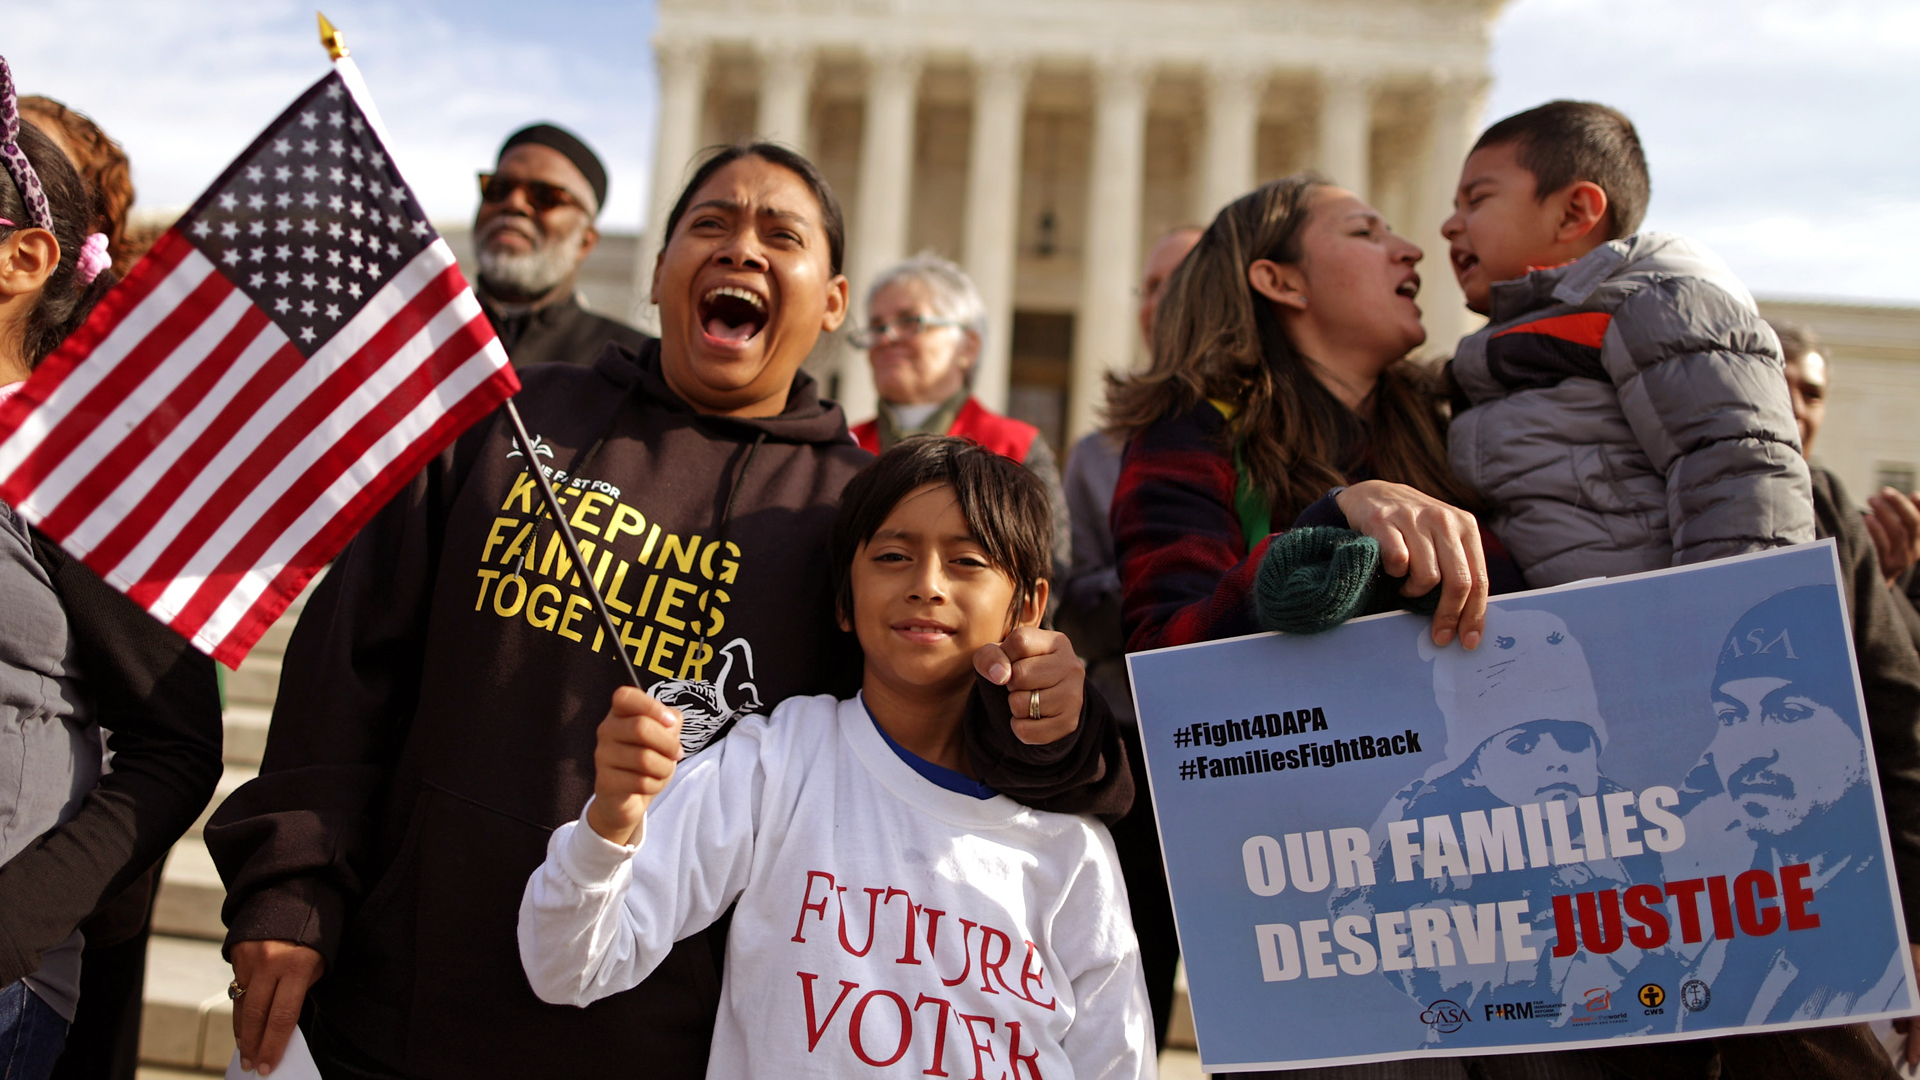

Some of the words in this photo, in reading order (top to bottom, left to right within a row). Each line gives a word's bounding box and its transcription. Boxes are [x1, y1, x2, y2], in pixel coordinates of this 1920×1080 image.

[501, 472, 742, 584] KEEPING
[591, 480, 621, 500] FOR
[475, 569, 714, 682] TOGETHER
[481, 517, 731, 638] FAMILIES
[1173, 707, 1328, 748] #Fight4DAPA
[1178, 729, 1422, 781] #FamiliesFightBack
[1241, 827, 1377, 897] OUR
[1387, 785, 1687, 882] FAMILIES
[791, 870, 1056, 1011] FUTURE
[1255, 899, 1537, 982] DESERVE
[1551, 862, 1821, 958] JUSTICE
[1420, 1009, 1472, 1025] CASA
[1484, 1001, 1534, 1021] FIRM
